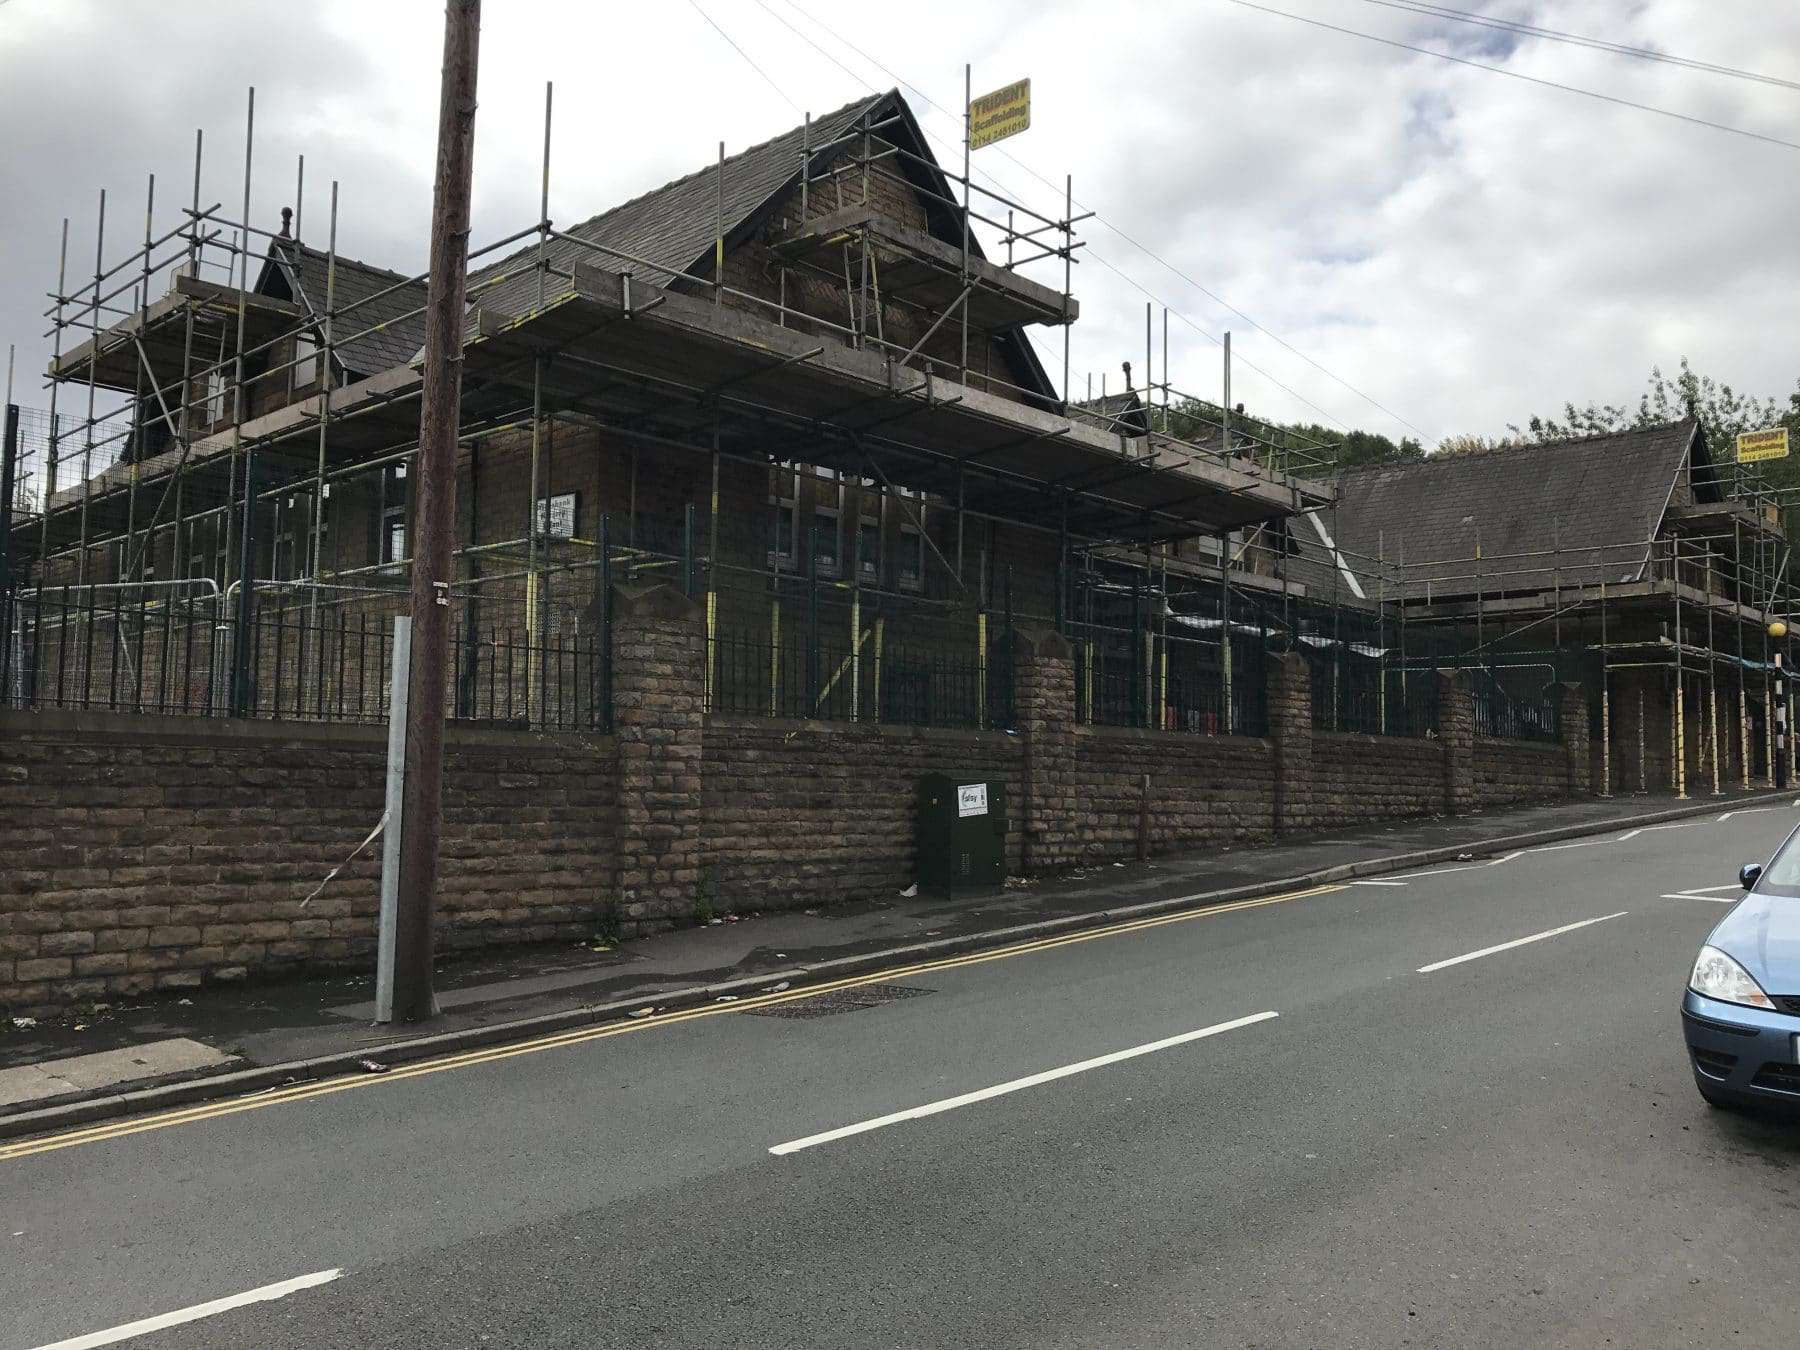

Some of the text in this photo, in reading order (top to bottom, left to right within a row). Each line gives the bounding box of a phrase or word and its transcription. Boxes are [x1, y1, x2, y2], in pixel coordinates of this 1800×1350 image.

[975, 81, 1027, 115] TRIDENT
[974, 105, 1026, 133] Scaffolding
[973, 133, 991, 148] 0114
[1740, 430, 1784, 445] TRIDENT
[1741, 443, 1785, 454] Scaffolding
